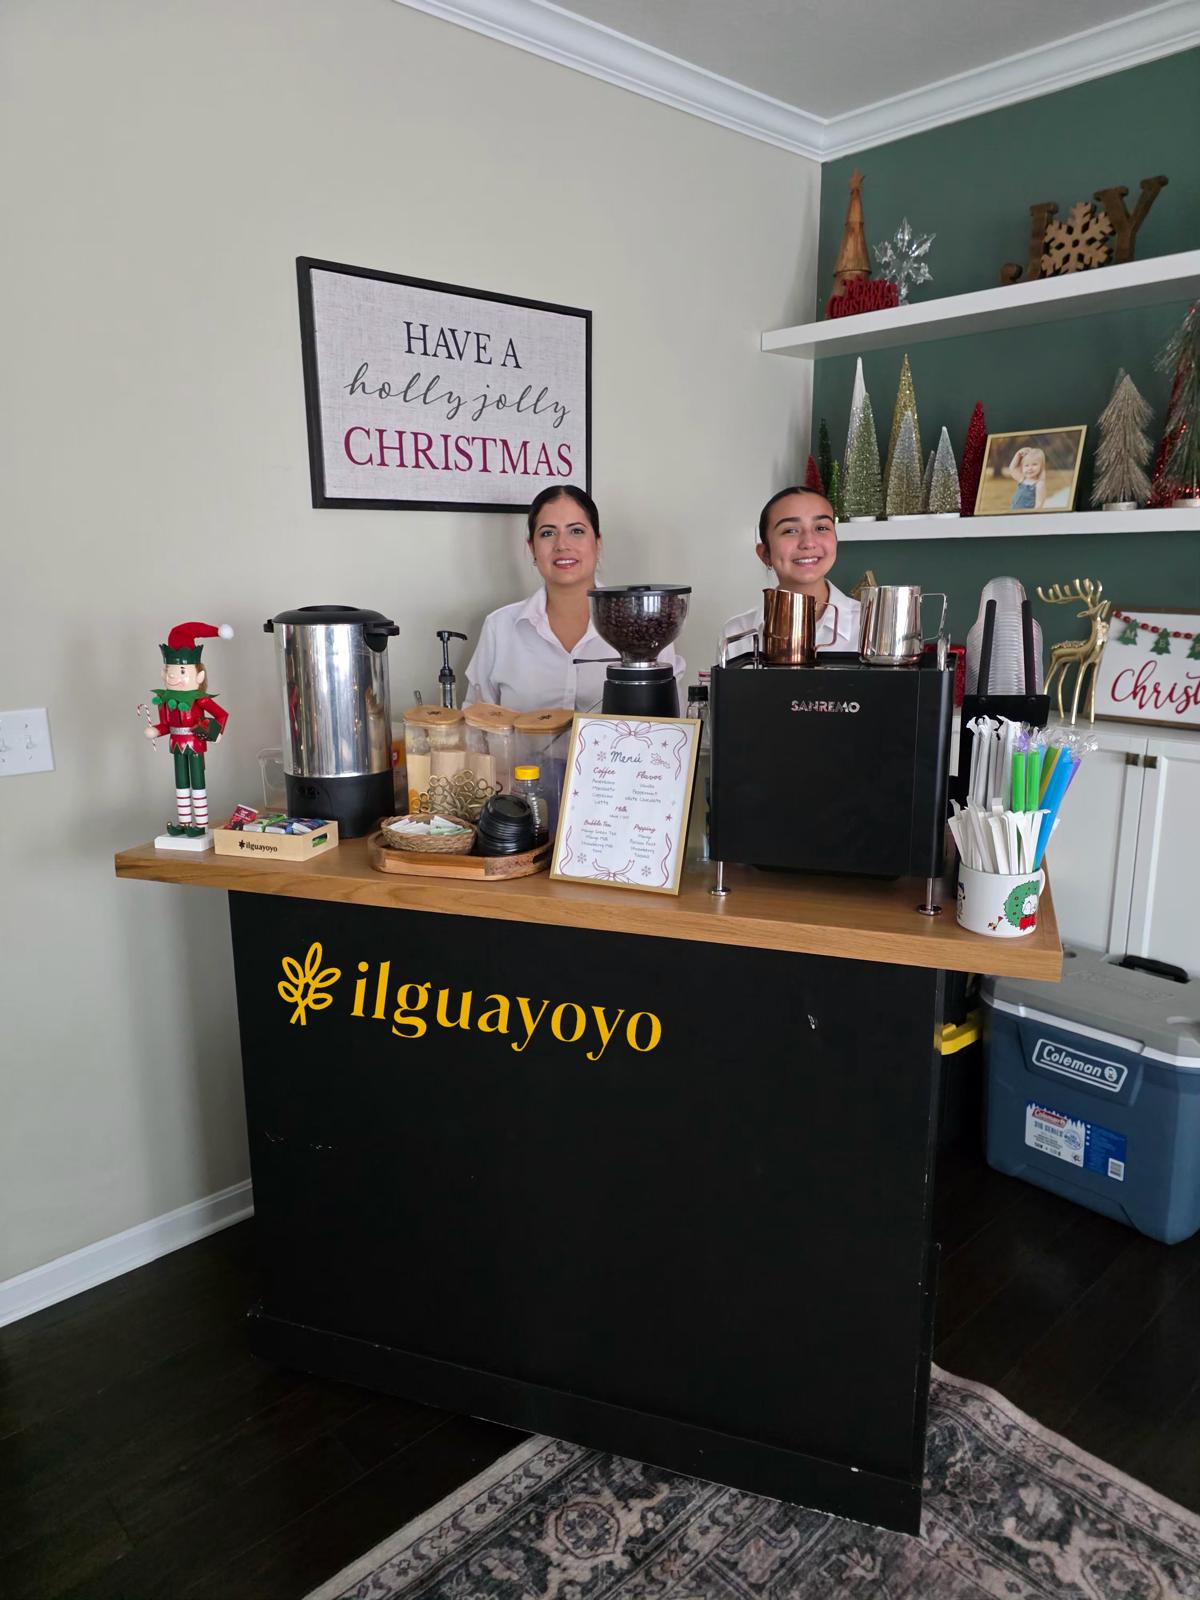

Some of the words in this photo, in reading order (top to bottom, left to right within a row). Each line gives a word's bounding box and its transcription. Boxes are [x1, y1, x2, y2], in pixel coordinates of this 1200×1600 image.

[403, 321, 493, 365] HAVE
[500, 338, 522, 369] A
[344, 362, 467, 420] holly
[472, 384, 571, 428] jolly
[344, 426, 573, 477] CHRISTMAS
[791, 699, 861, 713] SANREMO
[611, 750, 643, 763] Menú
[593, 767, 616, 779] Coffee
[636, 771, 663, 781] Flavor
[246, 841, 278, 853] ilguayoyo
[350, 960, 662, 1061] ilguayoyo
[1042, 1045, 1102, 1077] Coleman
